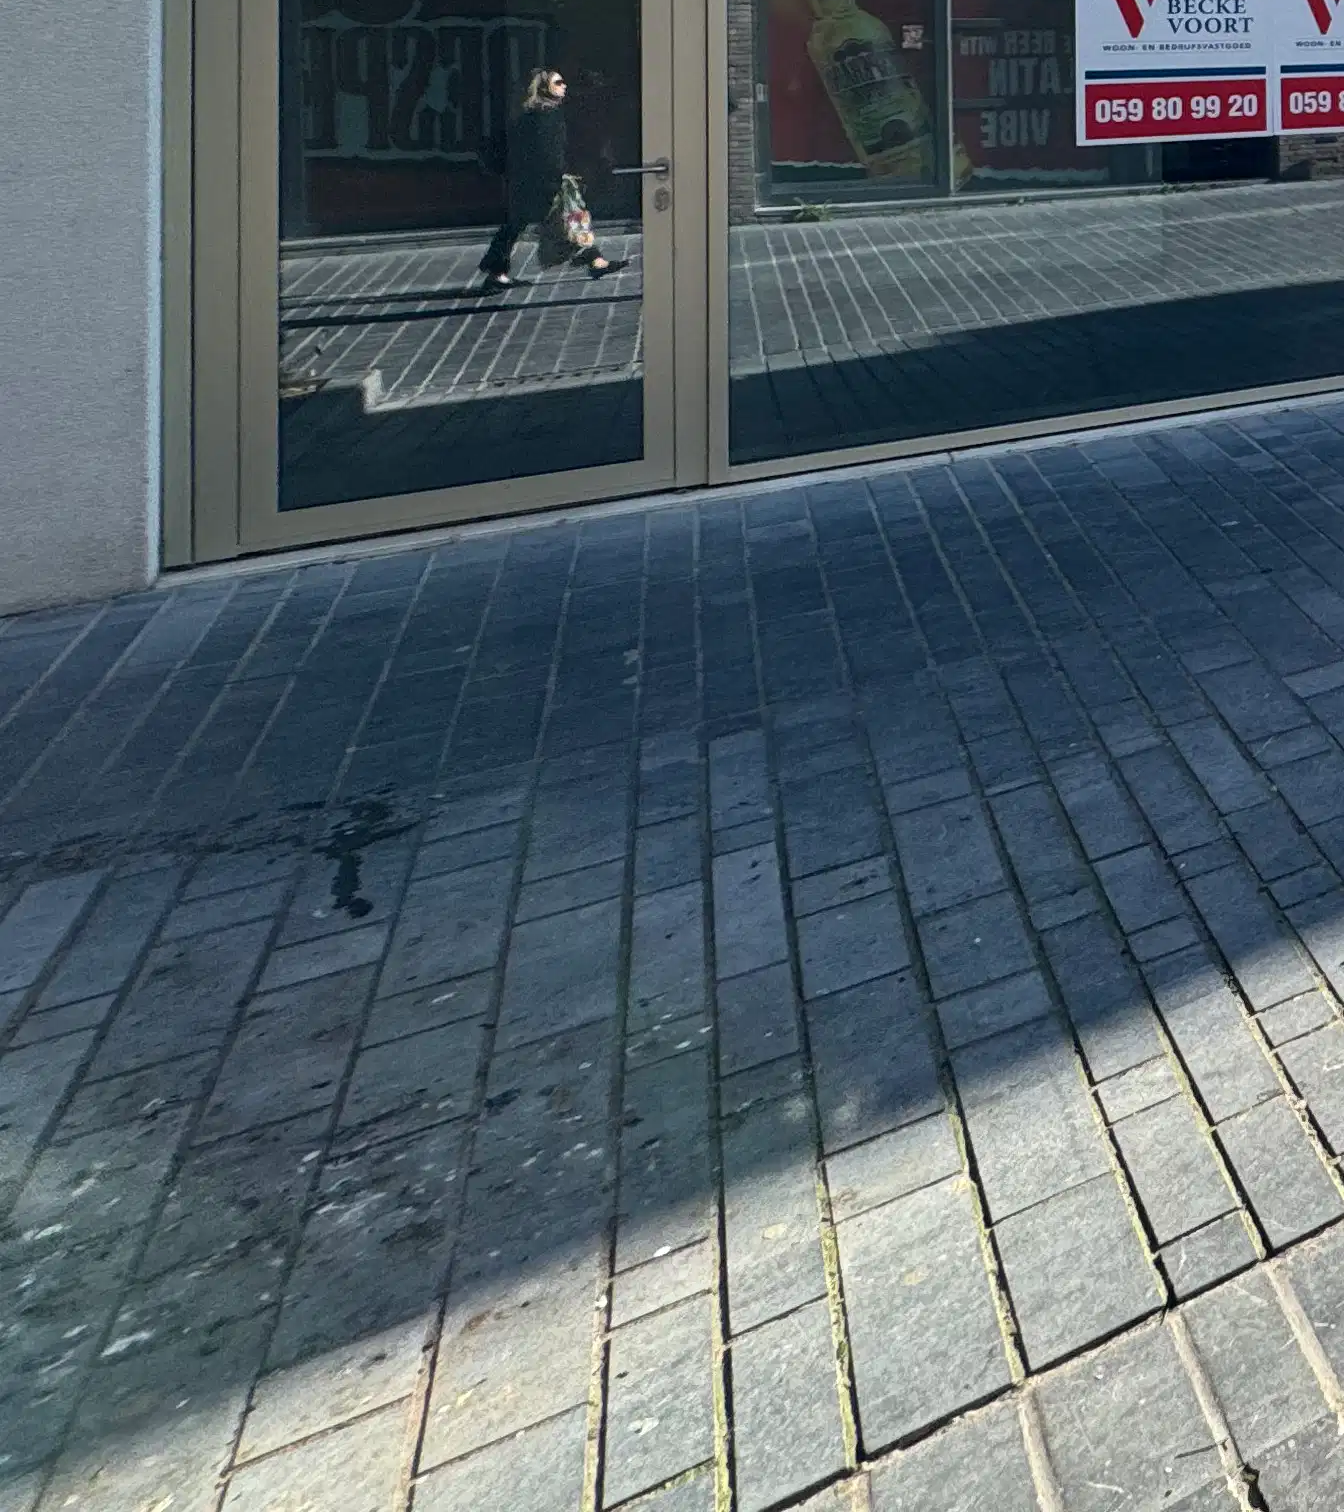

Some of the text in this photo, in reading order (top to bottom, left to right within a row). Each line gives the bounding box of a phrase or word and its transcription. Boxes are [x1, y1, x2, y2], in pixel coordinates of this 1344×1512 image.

[1167, 17, 1254, 34] VOORT
[1142, 43, 1155, 51] EN
[1095, 94, 1258, 123] 059 80 99 20
[1289, 91, 1332, 115] 059
